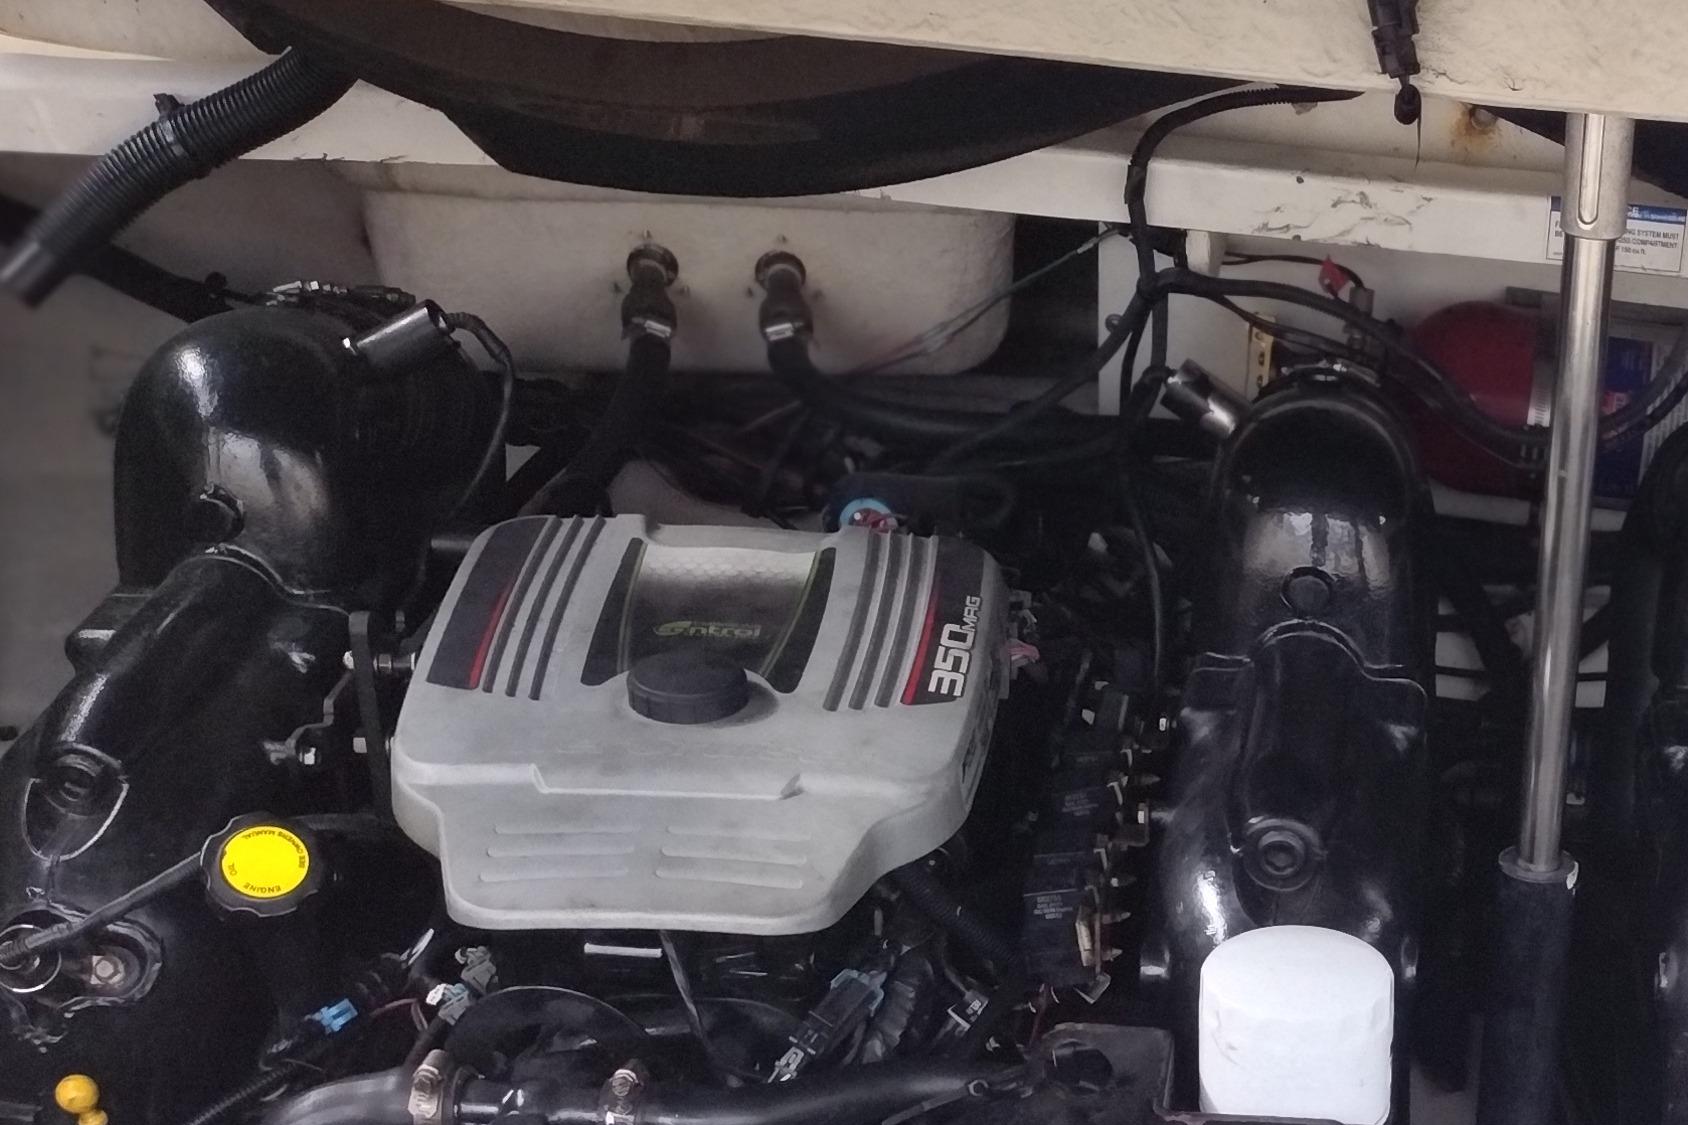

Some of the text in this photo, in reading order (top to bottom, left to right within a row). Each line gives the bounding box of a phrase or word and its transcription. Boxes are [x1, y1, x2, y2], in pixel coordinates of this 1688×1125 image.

[1637, 230, 1661, 238] SYSTEM
[928, 595, 982, 697] 350 MAG
[228, 862, 282, 893] ENGINE OIL
